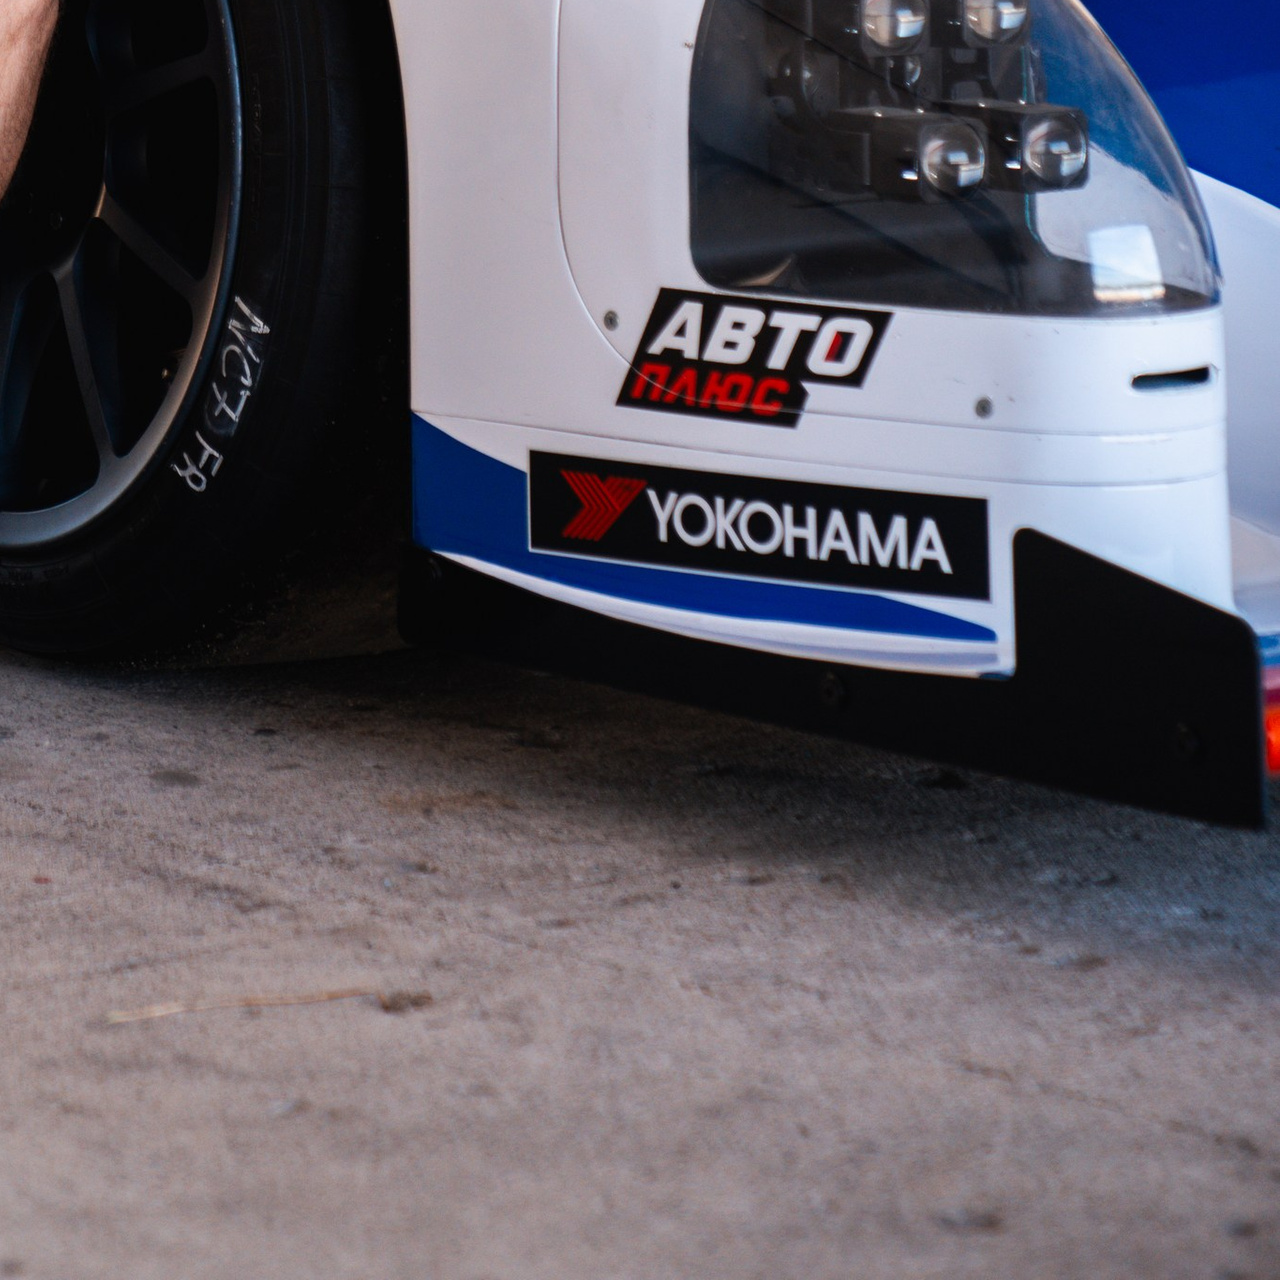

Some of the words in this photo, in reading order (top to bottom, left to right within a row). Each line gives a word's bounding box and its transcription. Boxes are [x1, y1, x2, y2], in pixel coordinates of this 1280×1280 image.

[648, 300, 874, 378] АВТО
[629, 362, 790, 417] ПЛЮС
[170, 430, 224, 492] FR
[646, 488, 953, 575] YOKOHAMA
